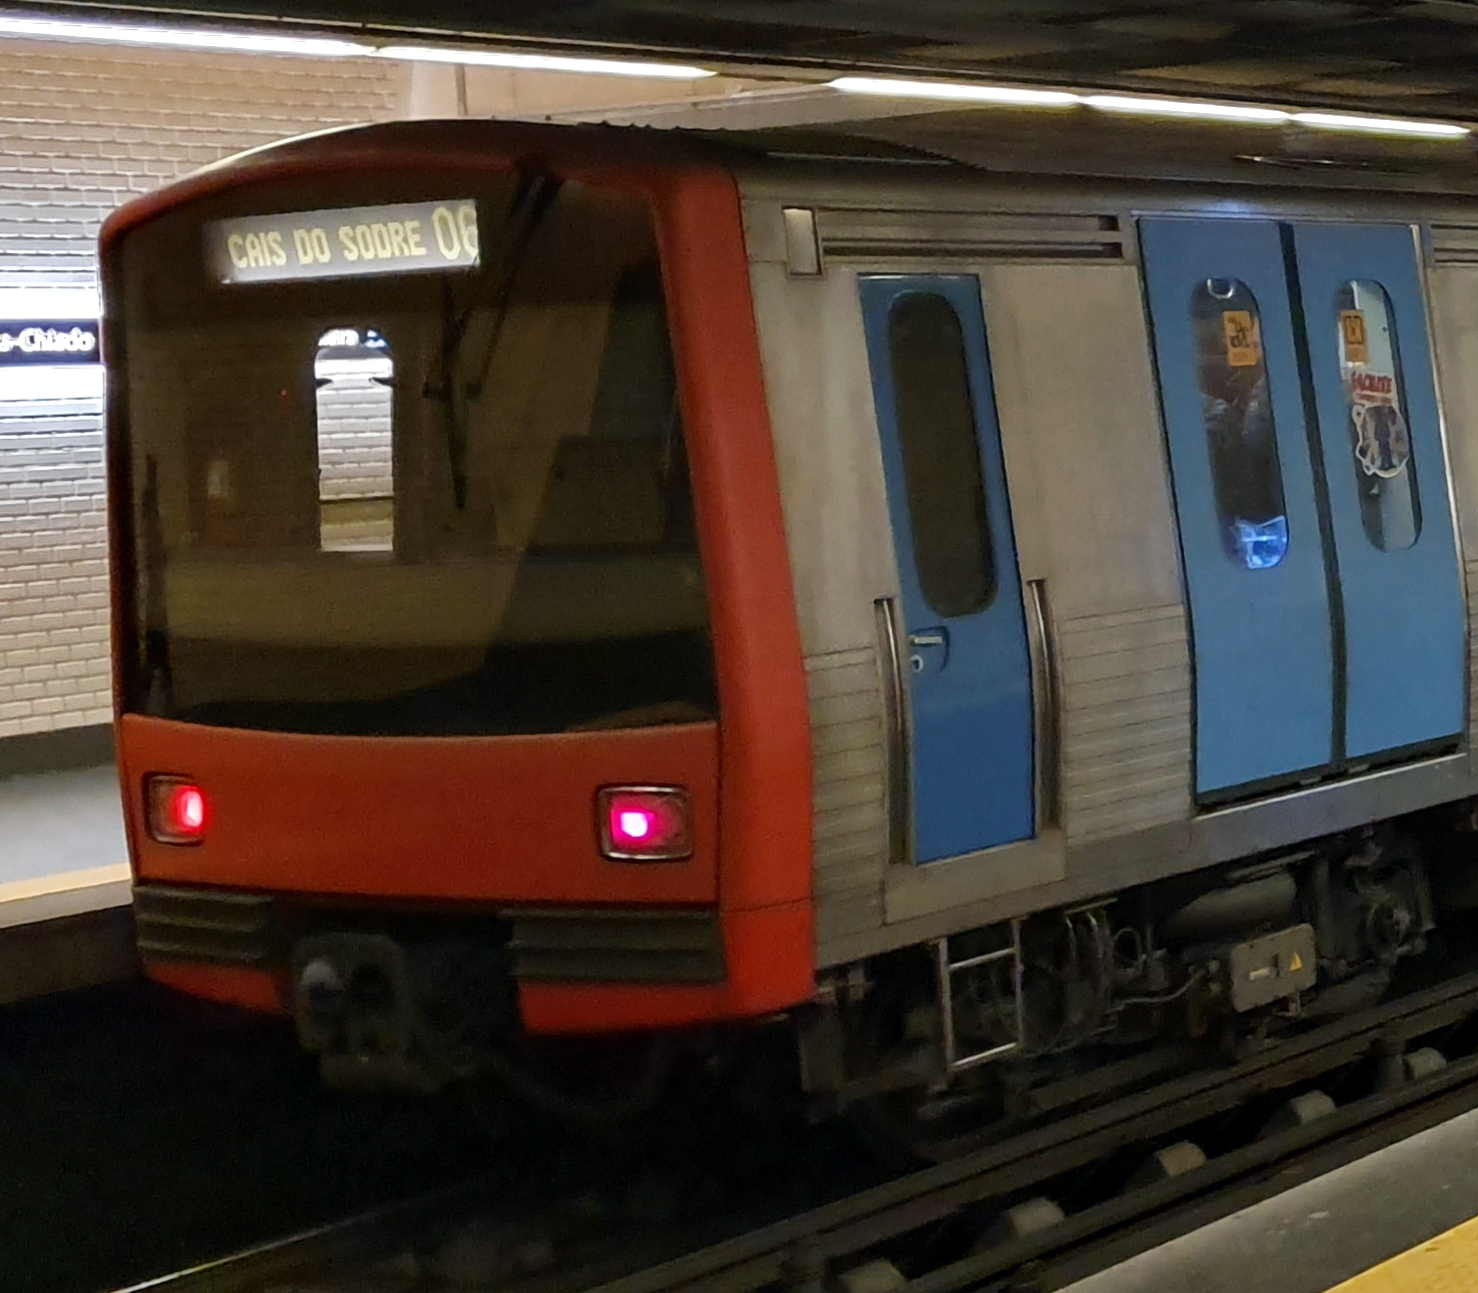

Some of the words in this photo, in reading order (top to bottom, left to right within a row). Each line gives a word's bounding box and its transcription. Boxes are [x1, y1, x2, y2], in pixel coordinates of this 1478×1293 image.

[227, 231, 287, 269] CAIS
[293, 227, 331, 265] DO
[338, 219, 428, 261] SODRE
